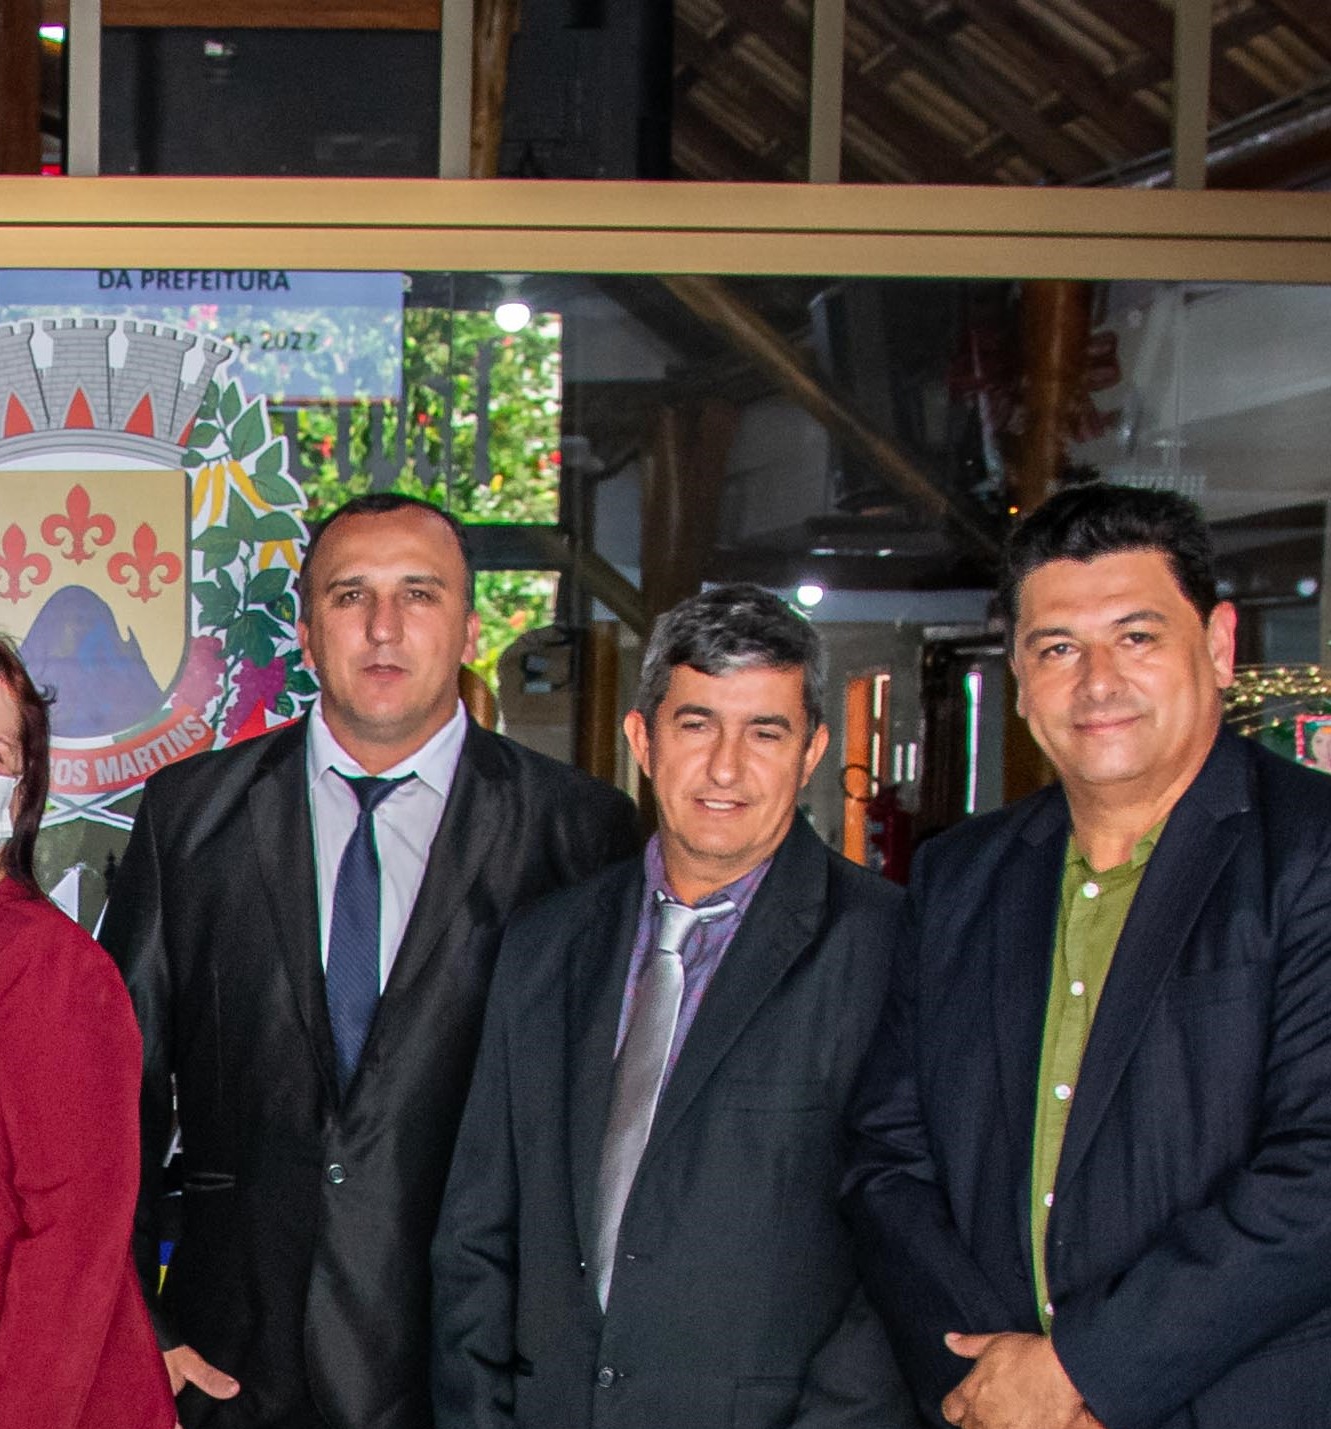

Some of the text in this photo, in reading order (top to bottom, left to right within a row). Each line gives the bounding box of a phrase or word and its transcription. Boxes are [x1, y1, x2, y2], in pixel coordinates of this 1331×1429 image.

[97, 270, 291, 291] DA PREFEITURA
[94, 714, 207, 785] MARTINS
